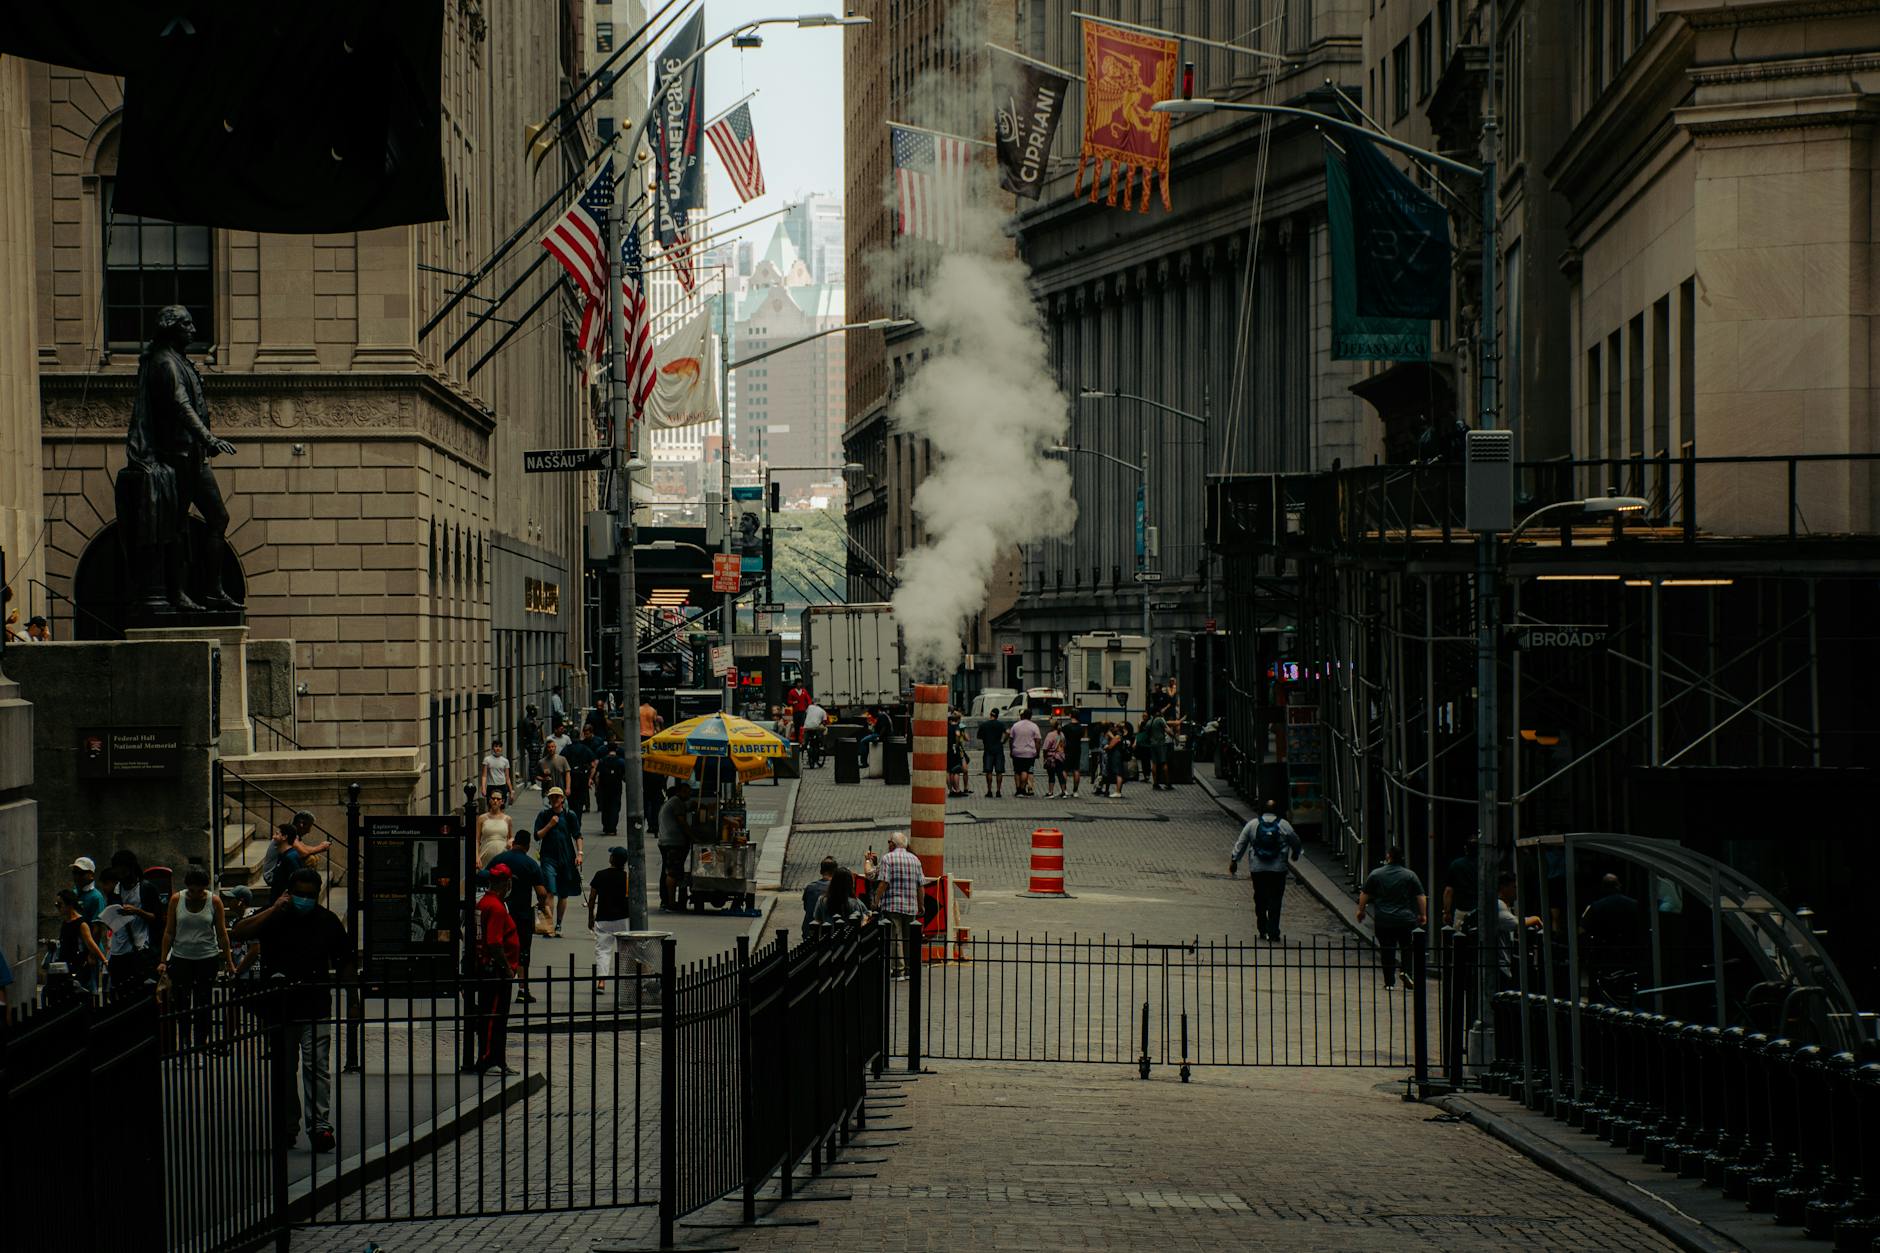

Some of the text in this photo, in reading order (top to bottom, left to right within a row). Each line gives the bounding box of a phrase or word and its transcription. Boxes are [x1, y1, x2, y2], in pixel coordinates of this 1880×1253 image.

[1020, 87, 1055, 182] CIPRIANI
[526, 454, 586, 469] NASSAU ST
[1532, 632, 1594, 647] BROAD
[113, 742, 143, 750] National
[652, 742, 684, 752] SABRETT
[732, 743, 779, 754] SABRETT
